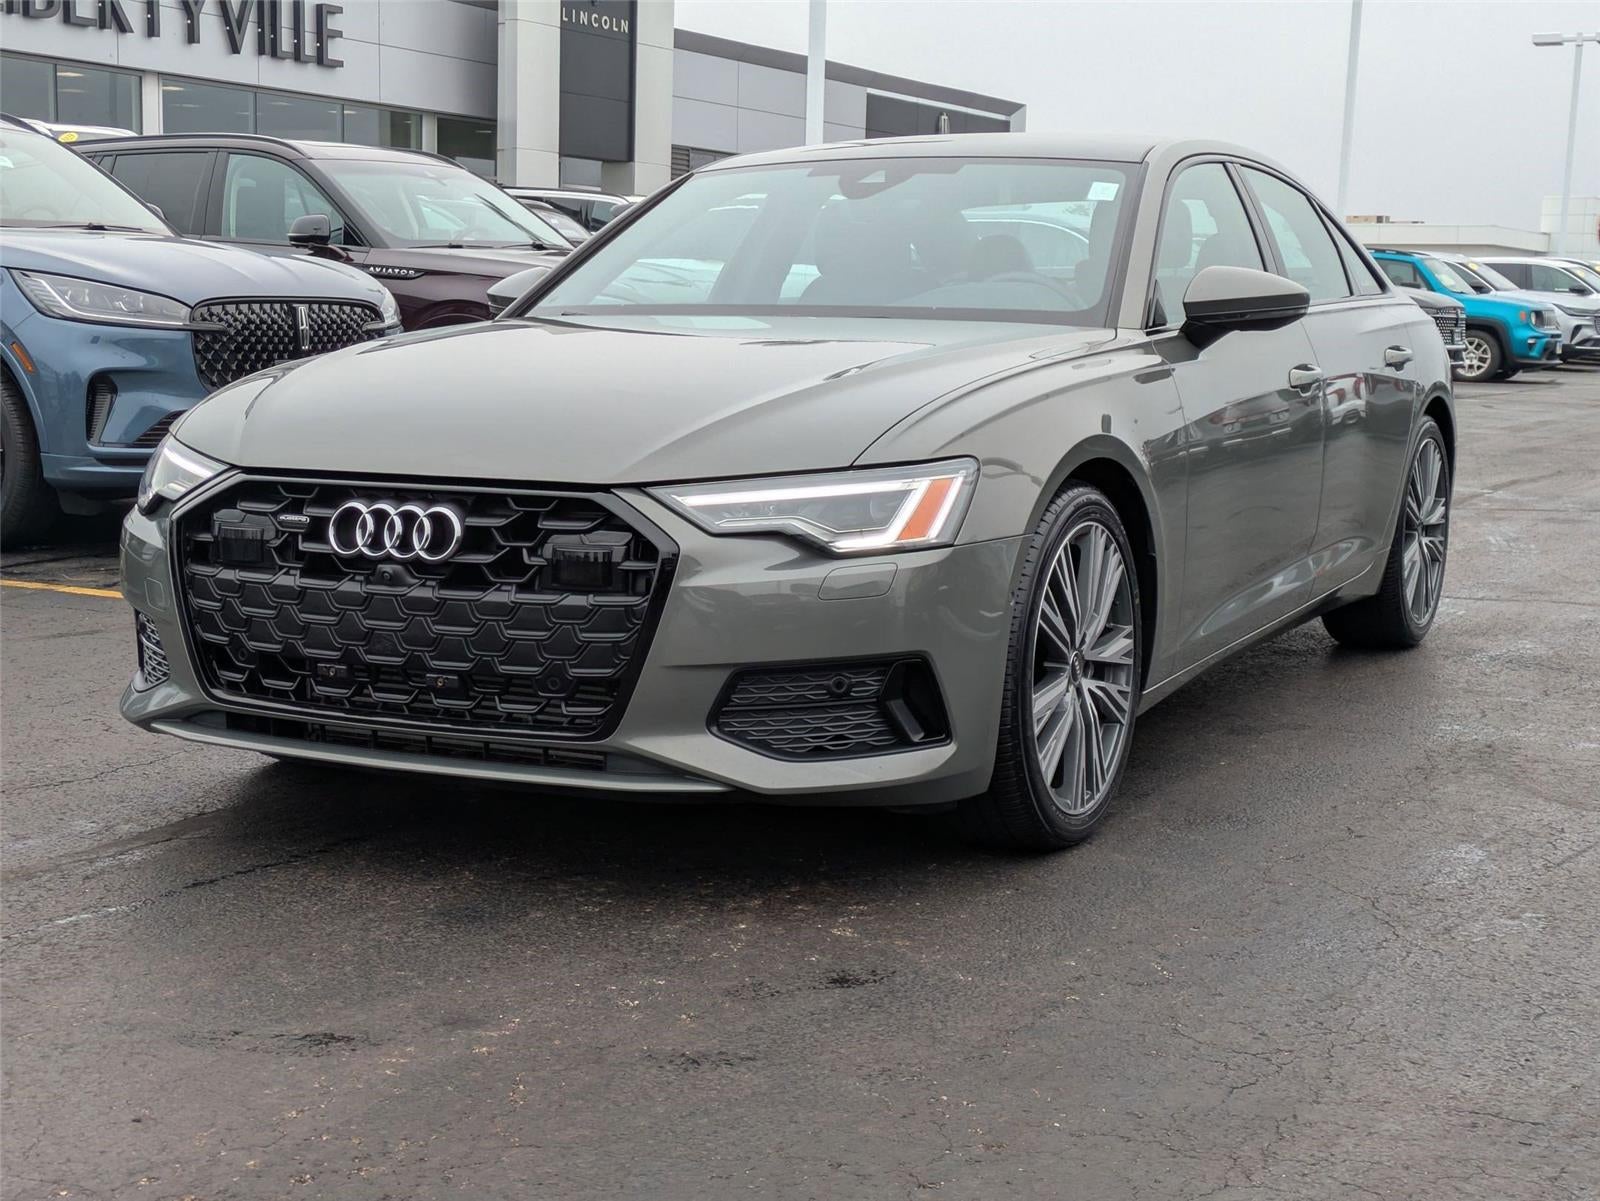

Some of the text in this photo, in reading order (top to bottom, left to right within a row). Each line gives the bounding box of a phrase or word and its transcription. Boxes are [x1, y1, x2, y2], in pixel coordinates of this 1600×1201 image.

[0, 0, 344, 68] YVILLE
[562, 7, 629, 34] LINCOLN
[368, 266, 416, 276] AVIATOR
